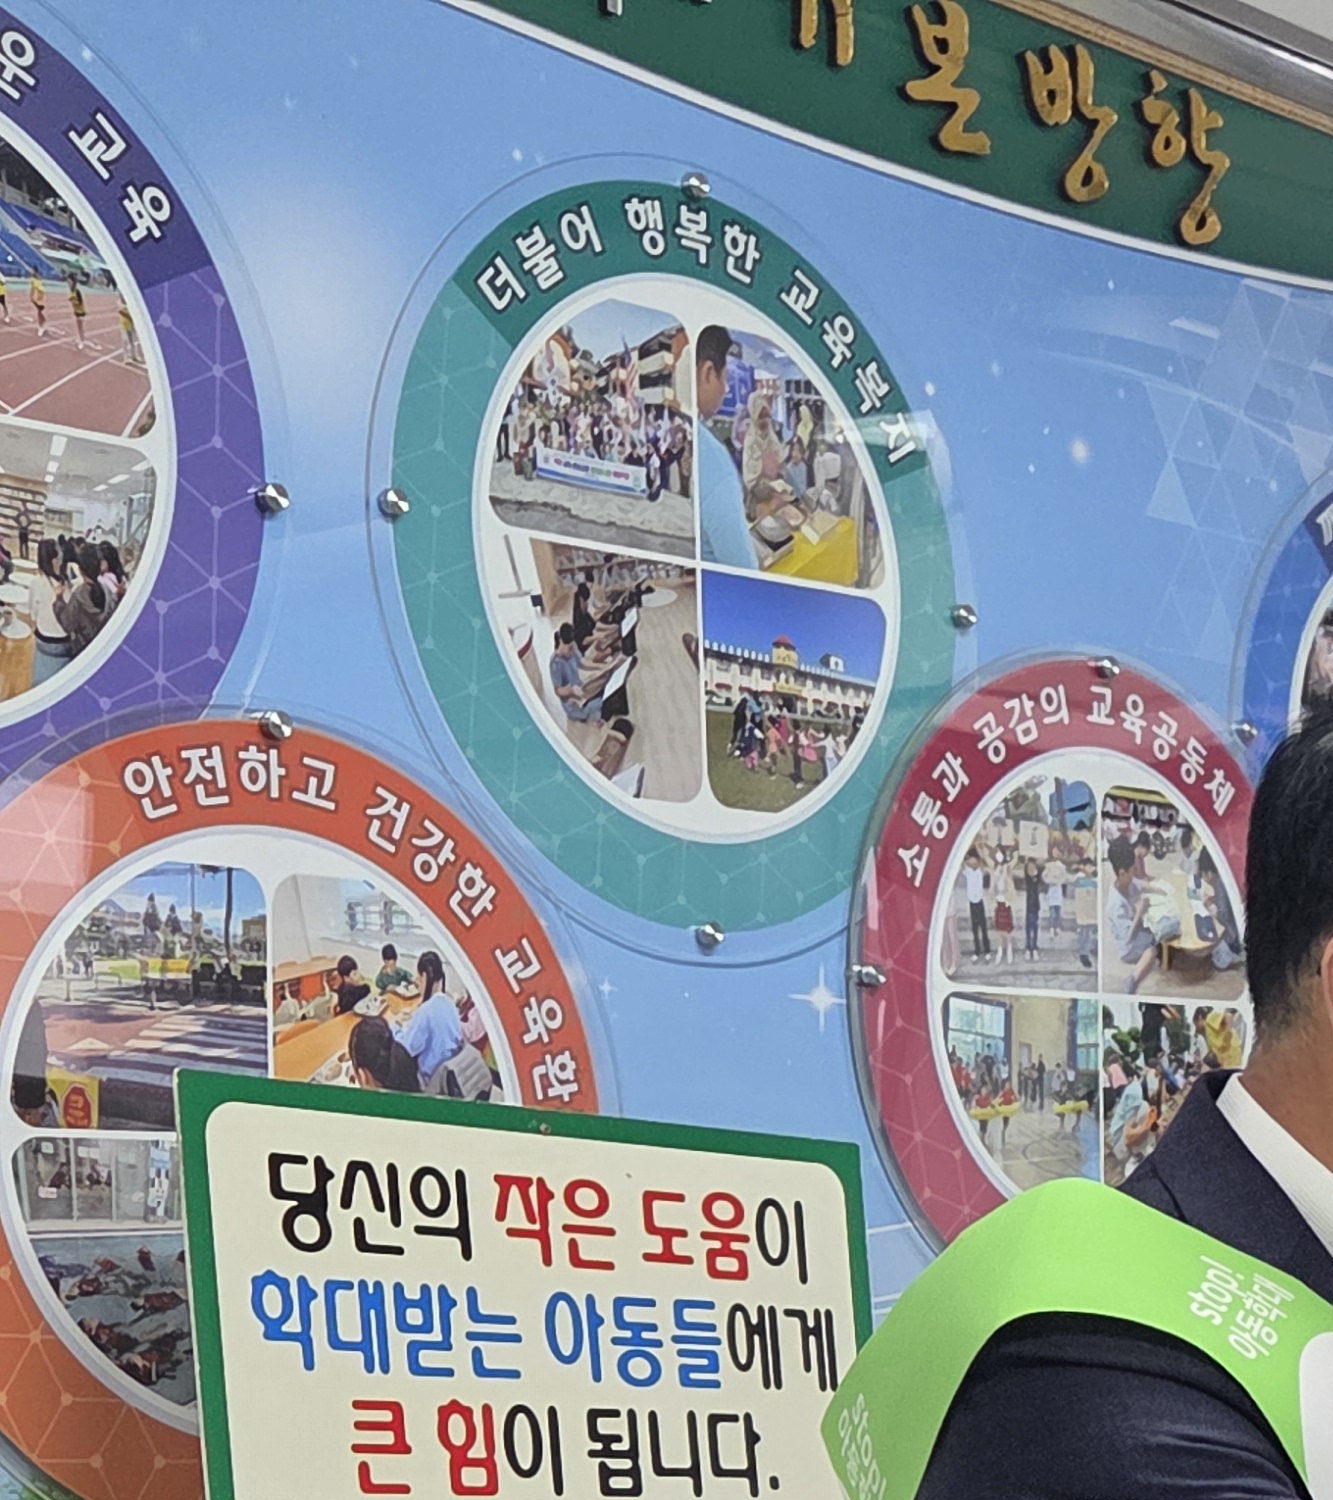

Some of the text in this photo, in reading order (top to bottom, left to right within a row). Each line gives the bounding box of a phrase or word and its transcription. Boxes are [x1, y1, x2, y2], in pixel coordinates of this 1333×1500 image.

[68, 112, 171, 243] 교육
[477, 196, 918, 464] 더불어 행복한 교육복지
[122, 744, 337, 820] 안전하고
[363, 785, 497, 928] 건강한
[896, 684, 1236, 888] 소통과 공감의 교육공동체
[267, 1151, 808, 1285] 당신의 작은 도움이
[250, 1268, 839, 1393] 학대받는 아동들에게
[1187, 1254, 1247, 1326] stop!
[1227, 1272, 1296, 1360] 아동학대
[351, 1397, 781, 1498] 큰 힘이 됩니다.
